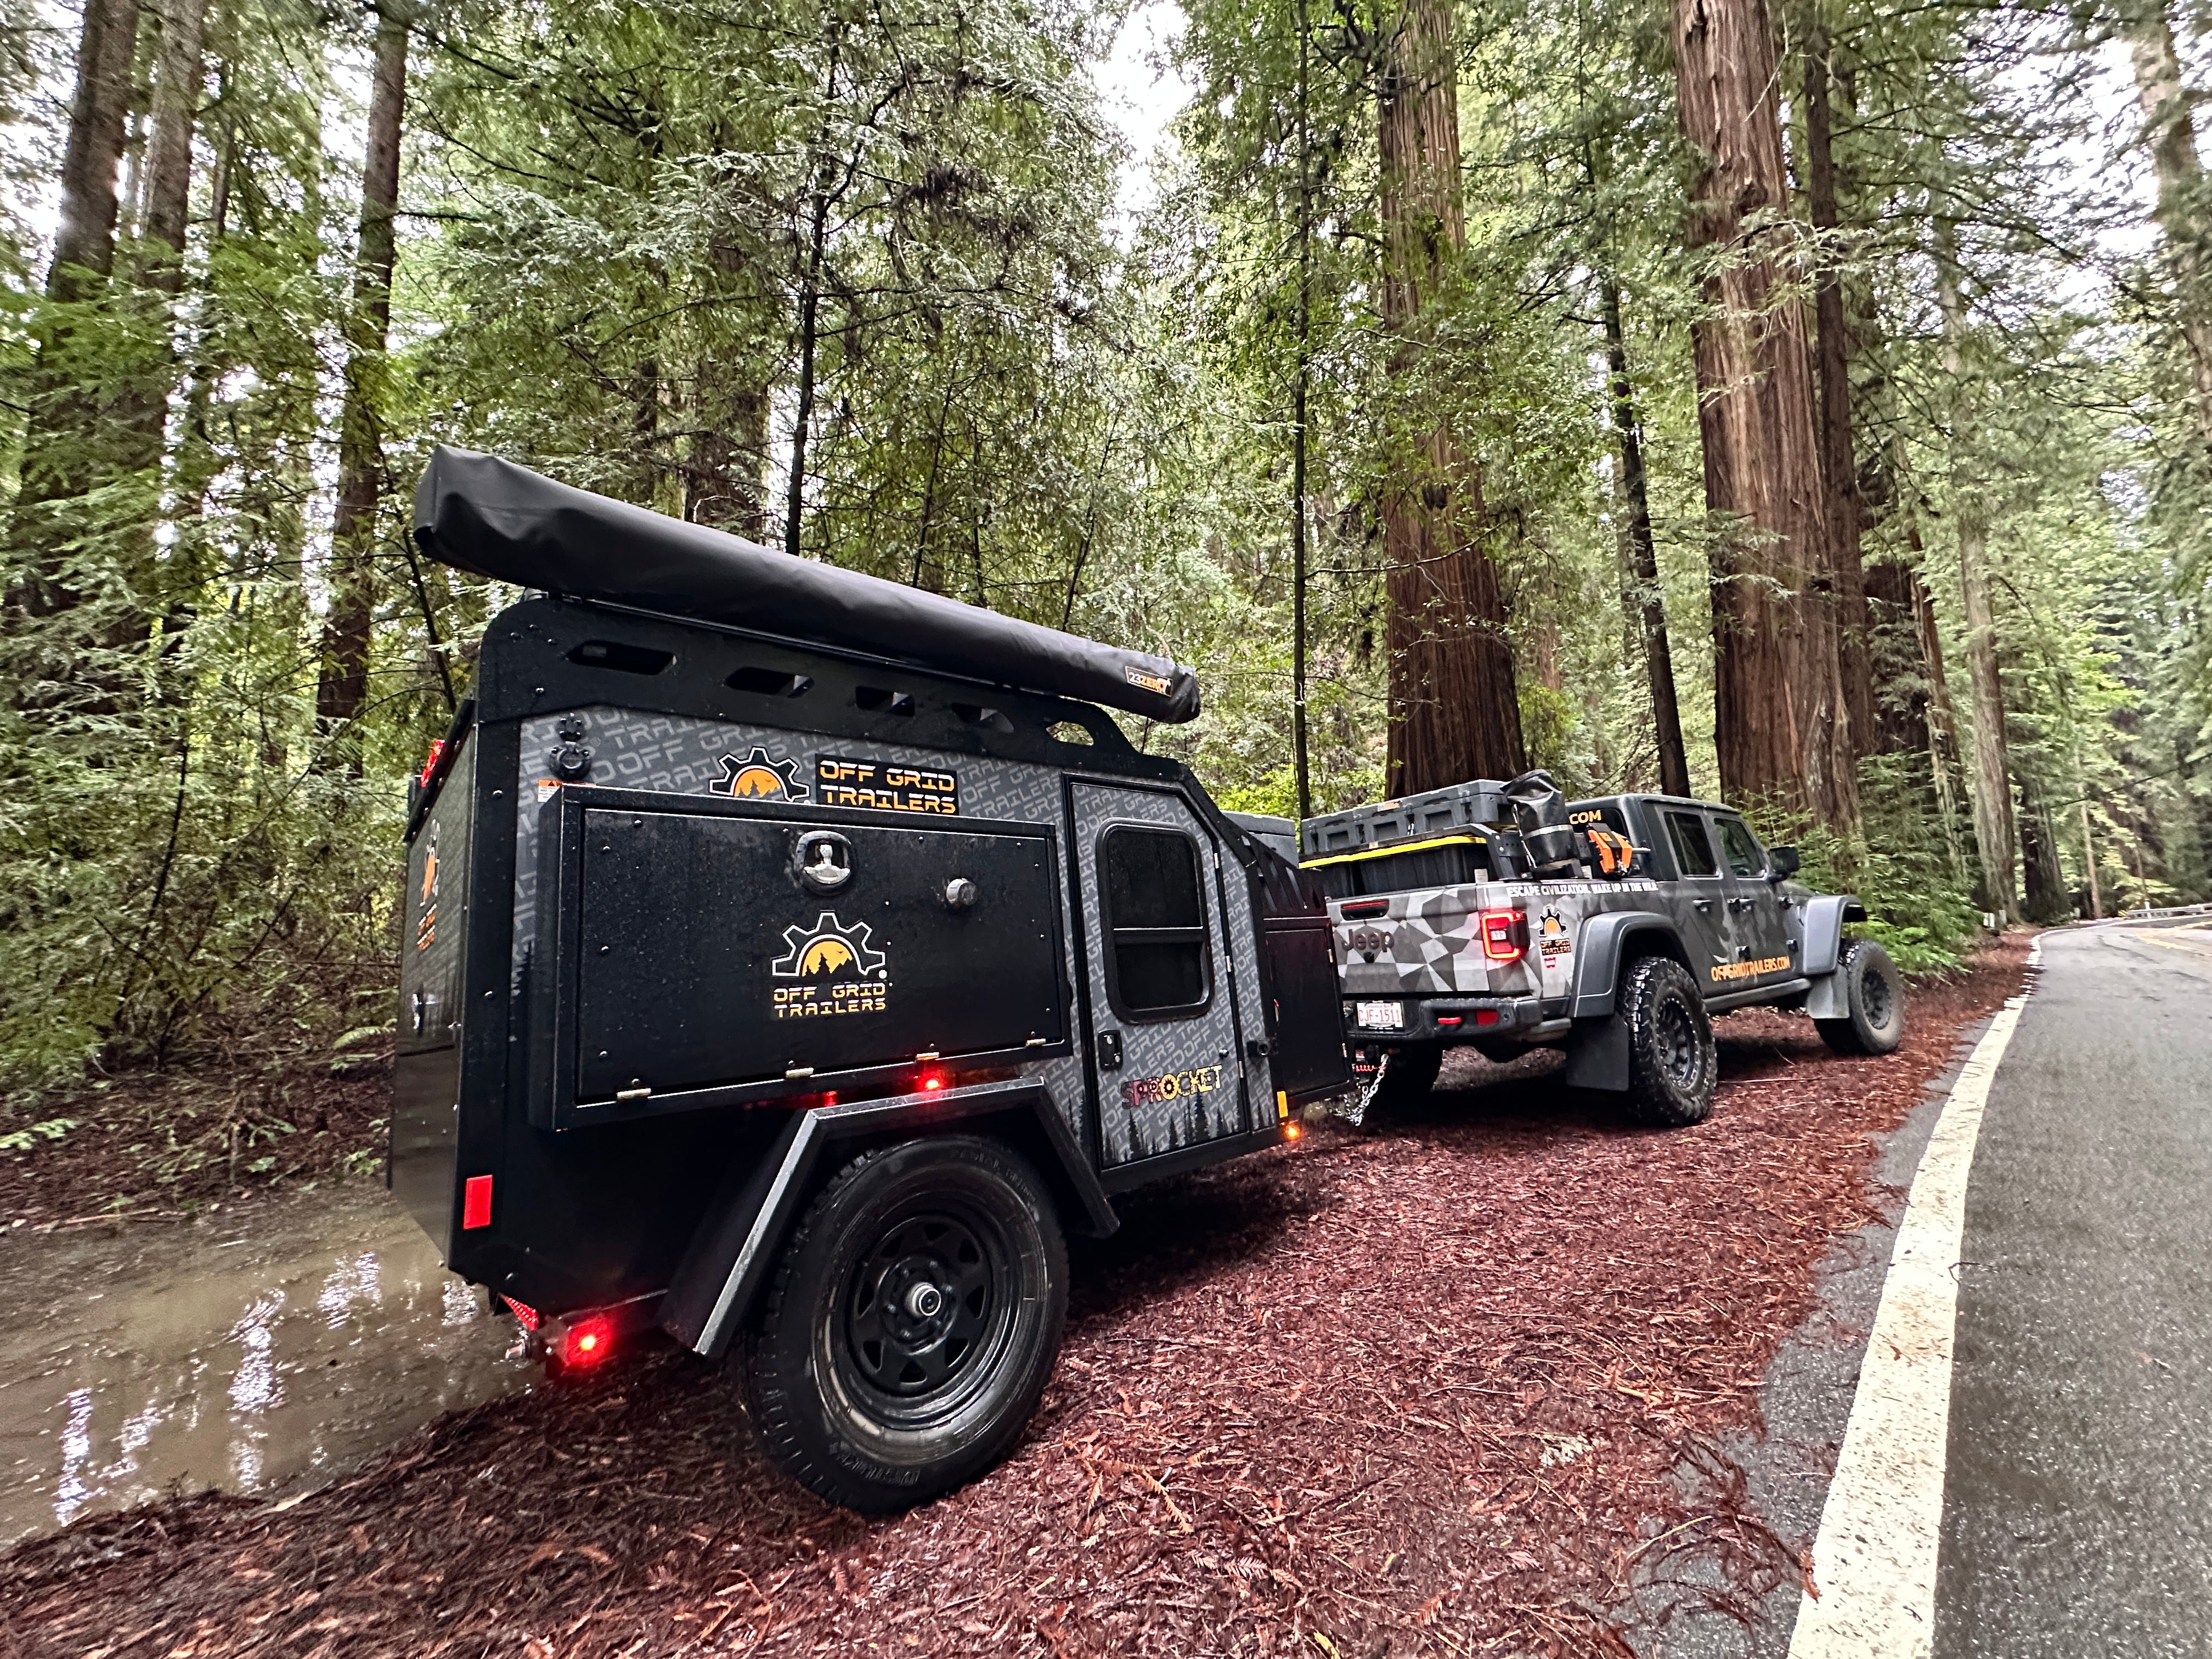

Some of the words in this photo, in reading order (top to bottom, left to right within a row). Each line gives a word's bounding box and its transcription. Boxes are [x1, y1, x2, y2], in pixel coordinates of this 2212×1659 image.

[1128, 672, 1166, 693] 23ZERO
[820, 760, 876, 782] OFF
[886, 768, 955, 792] GRID
[820, 784, 956, 814] TRAILERS
[1506, 885, 1541, 898] ESCAPE
[1341, 929, 1395, 953] Jeep
[1542, 946, 1571, 955] TRAILERS
[774, 986, 817, 1002] OFF
[832, 982, 886, 998] GRID
[774, 997, 887, 1018] TRAILERS
[1120, 1064, 1222, 1109] SPROCKET
